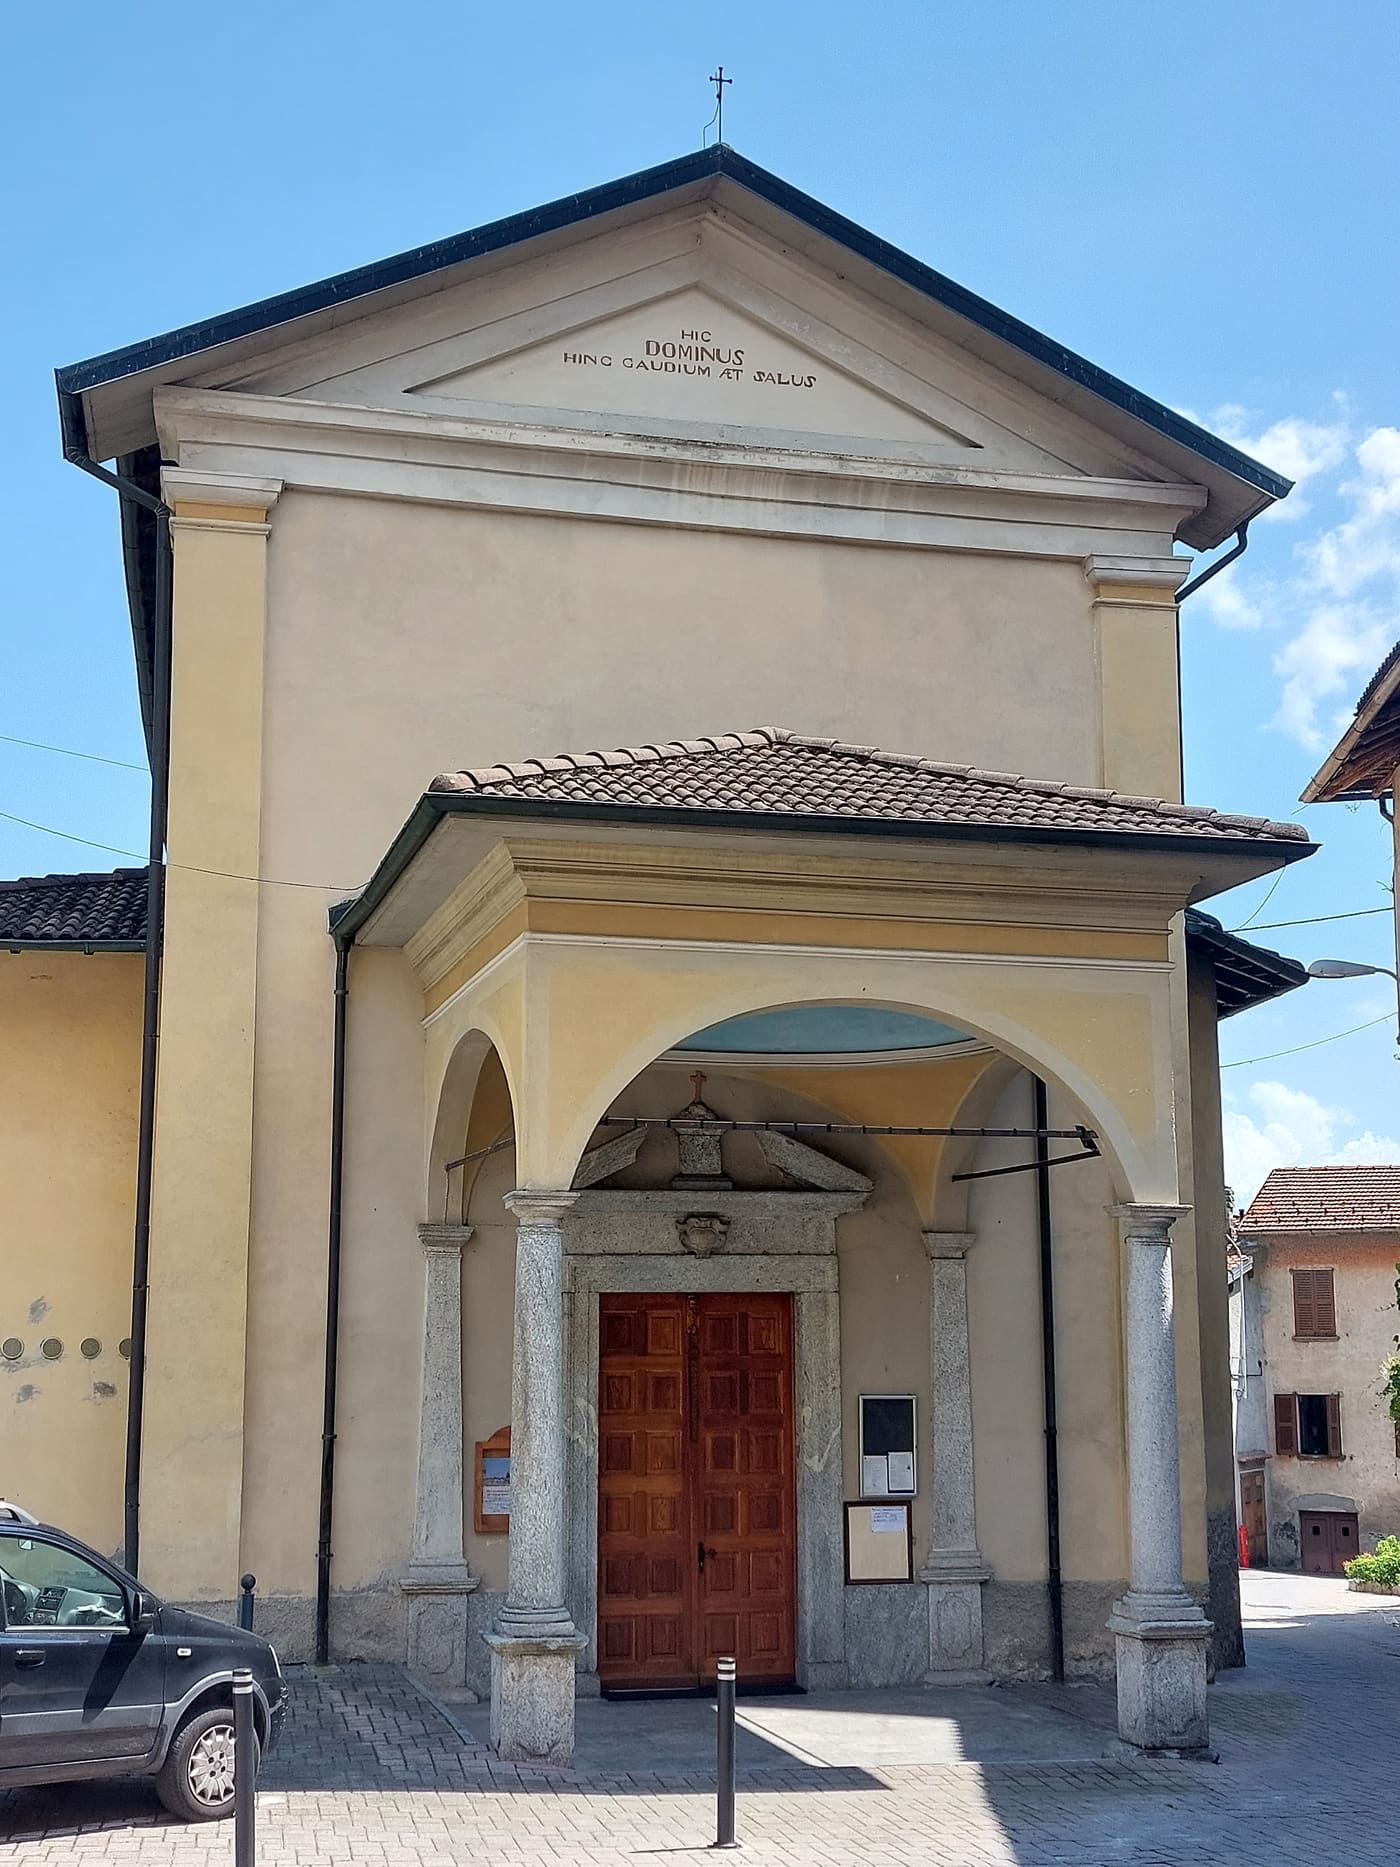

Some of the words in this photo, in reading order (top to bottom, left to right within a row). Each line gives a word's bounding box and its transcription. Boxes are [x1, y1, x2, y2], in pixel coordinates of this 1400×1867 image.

[681, 329, 712, 343] HIC
[645, 340, 745, 366] DOMINUS
[622, 357, 711, 378] GAUDIUM
[753, 370, 817, 388] SALUS
